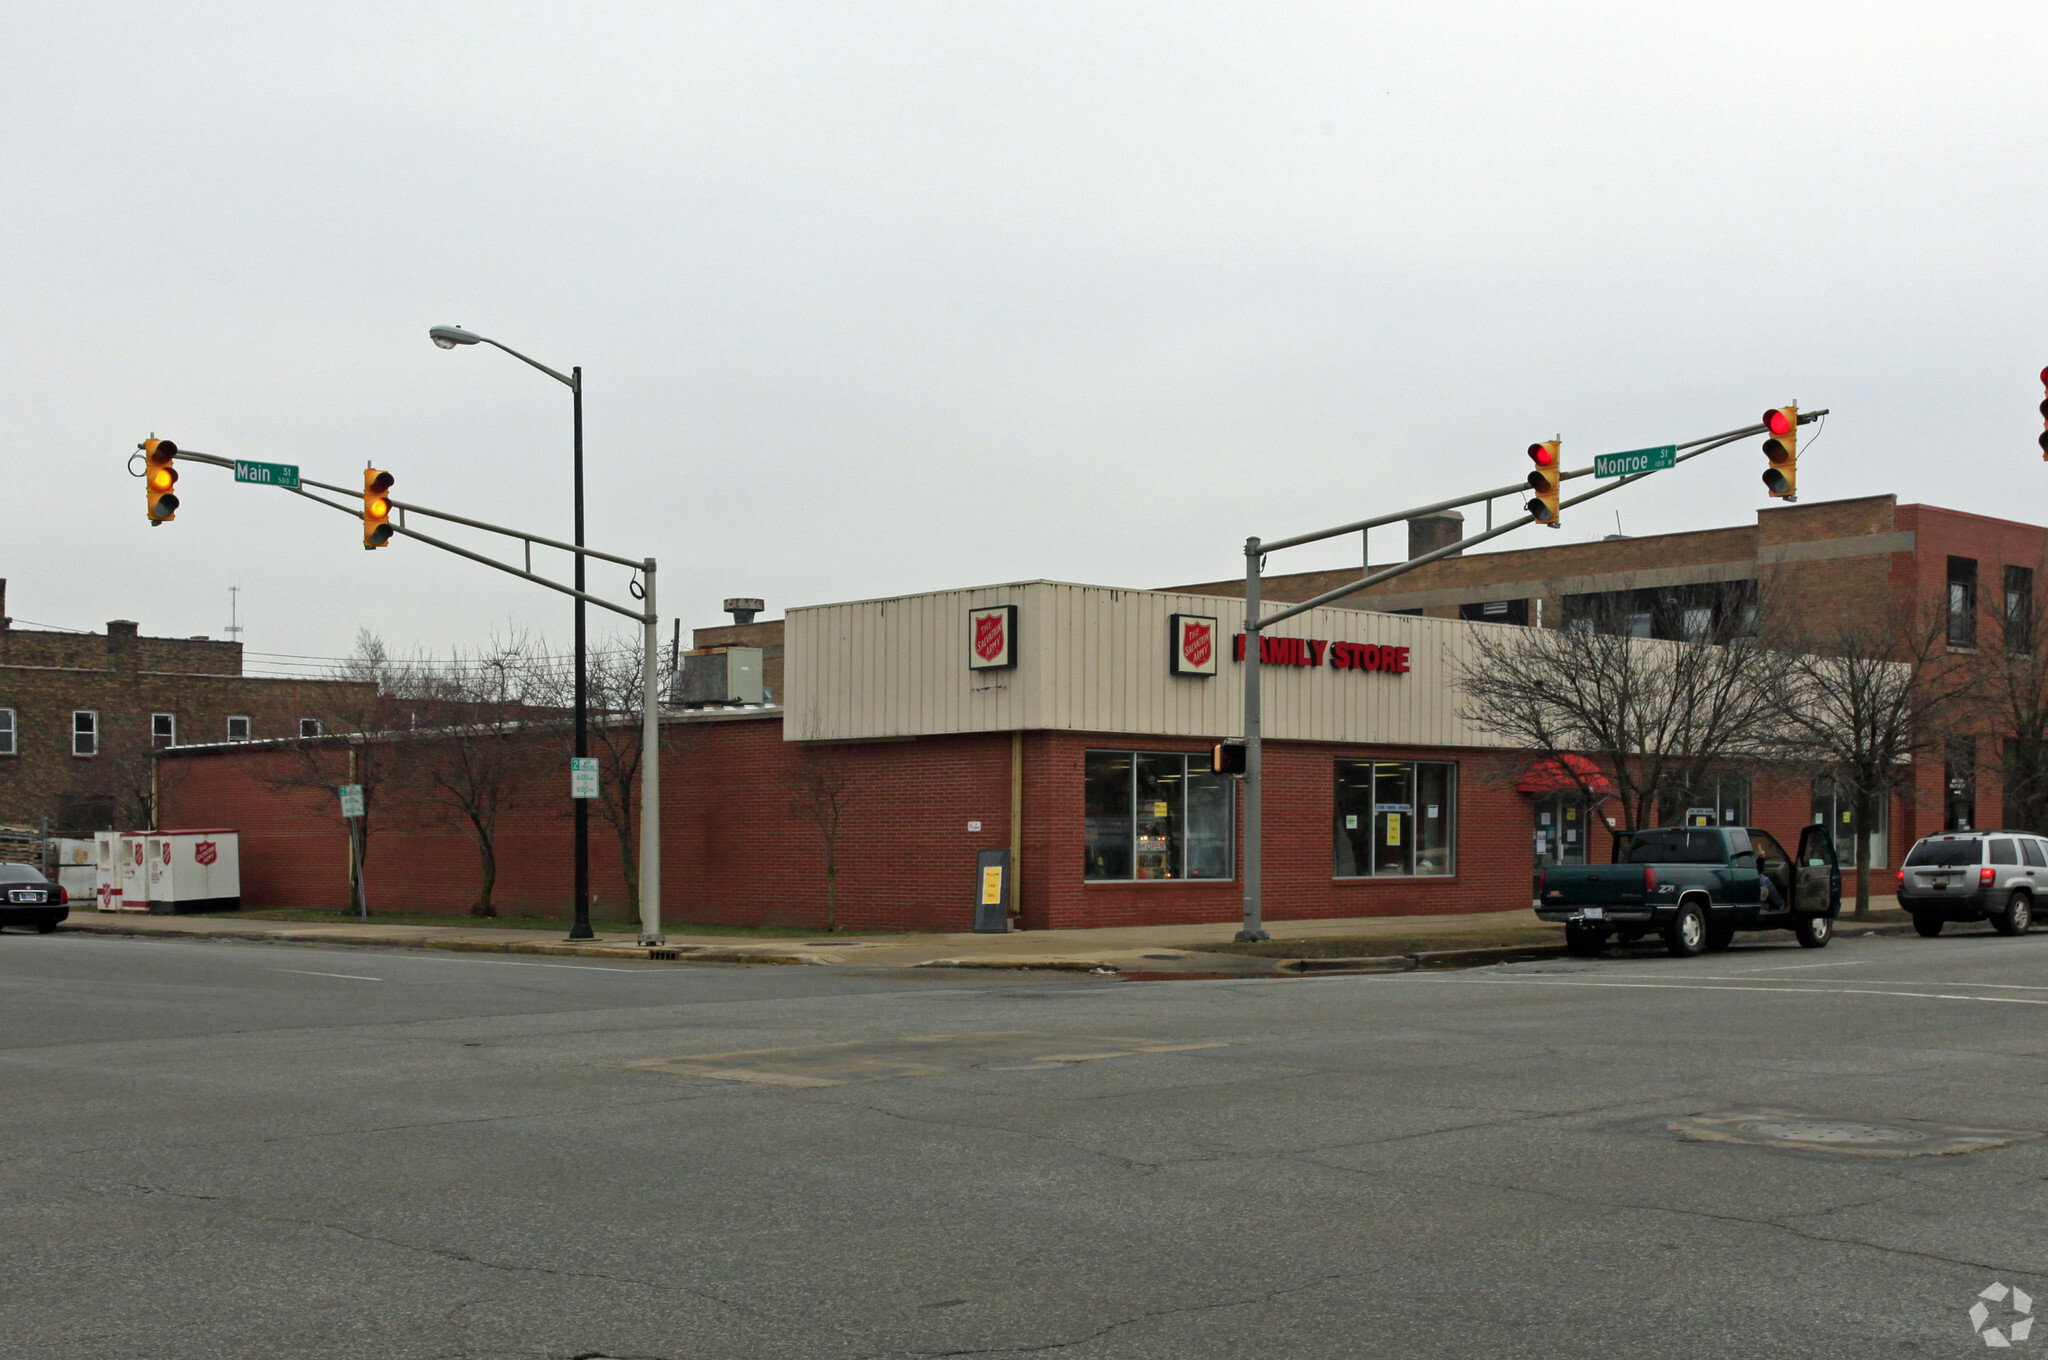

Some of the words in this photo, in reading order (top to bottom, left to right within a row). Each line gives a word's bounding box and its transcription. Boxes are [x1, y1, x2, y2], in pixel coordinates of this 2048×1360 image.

[1597, 455, 1648, 475] Monroe
[1660, 449, 1669, 458] St
[237, 463, 270, 482] Main
[284, 467, 291, 476] St
[1331, 641, 1410, 673] STORE
[572, 760, 579, 770] 2
[1147, 842, 1165, 850] OPEN
[1658, 885, 1675, 893] Z71
